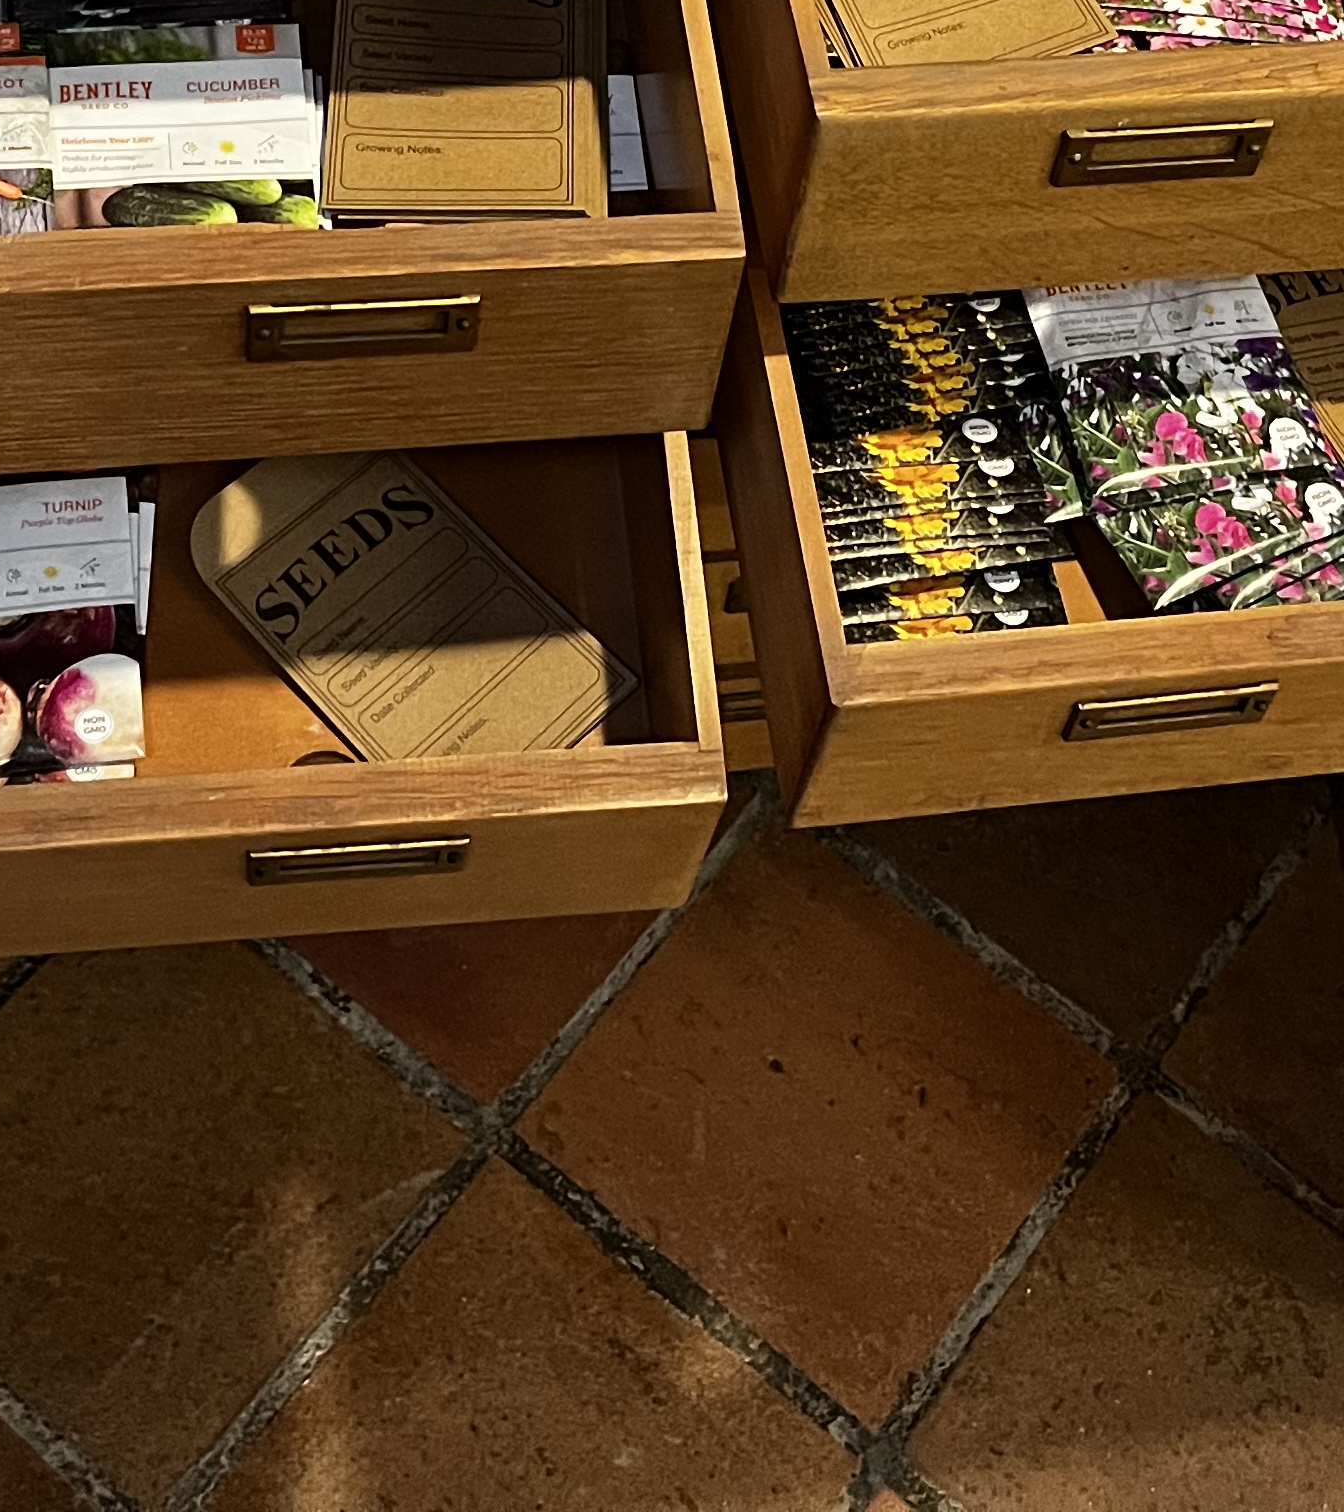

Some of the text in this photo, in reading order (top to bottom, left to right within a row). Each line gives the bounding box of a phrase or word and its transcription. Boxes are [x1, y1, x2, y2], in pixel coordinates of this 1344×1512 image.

[59, 80, 152, 104] BENTLEY
[186, 78, 280, 93] CUCUMBER
[356, 143, 404, 157] Growing
[43, 498, 103, 515] TURNIP
[256, 485, 434, 643] SEEDS
[370, 697, 396, 725] Date
[83, 715, 105, 726] NON
[84, 725, 107, 735] GMO
